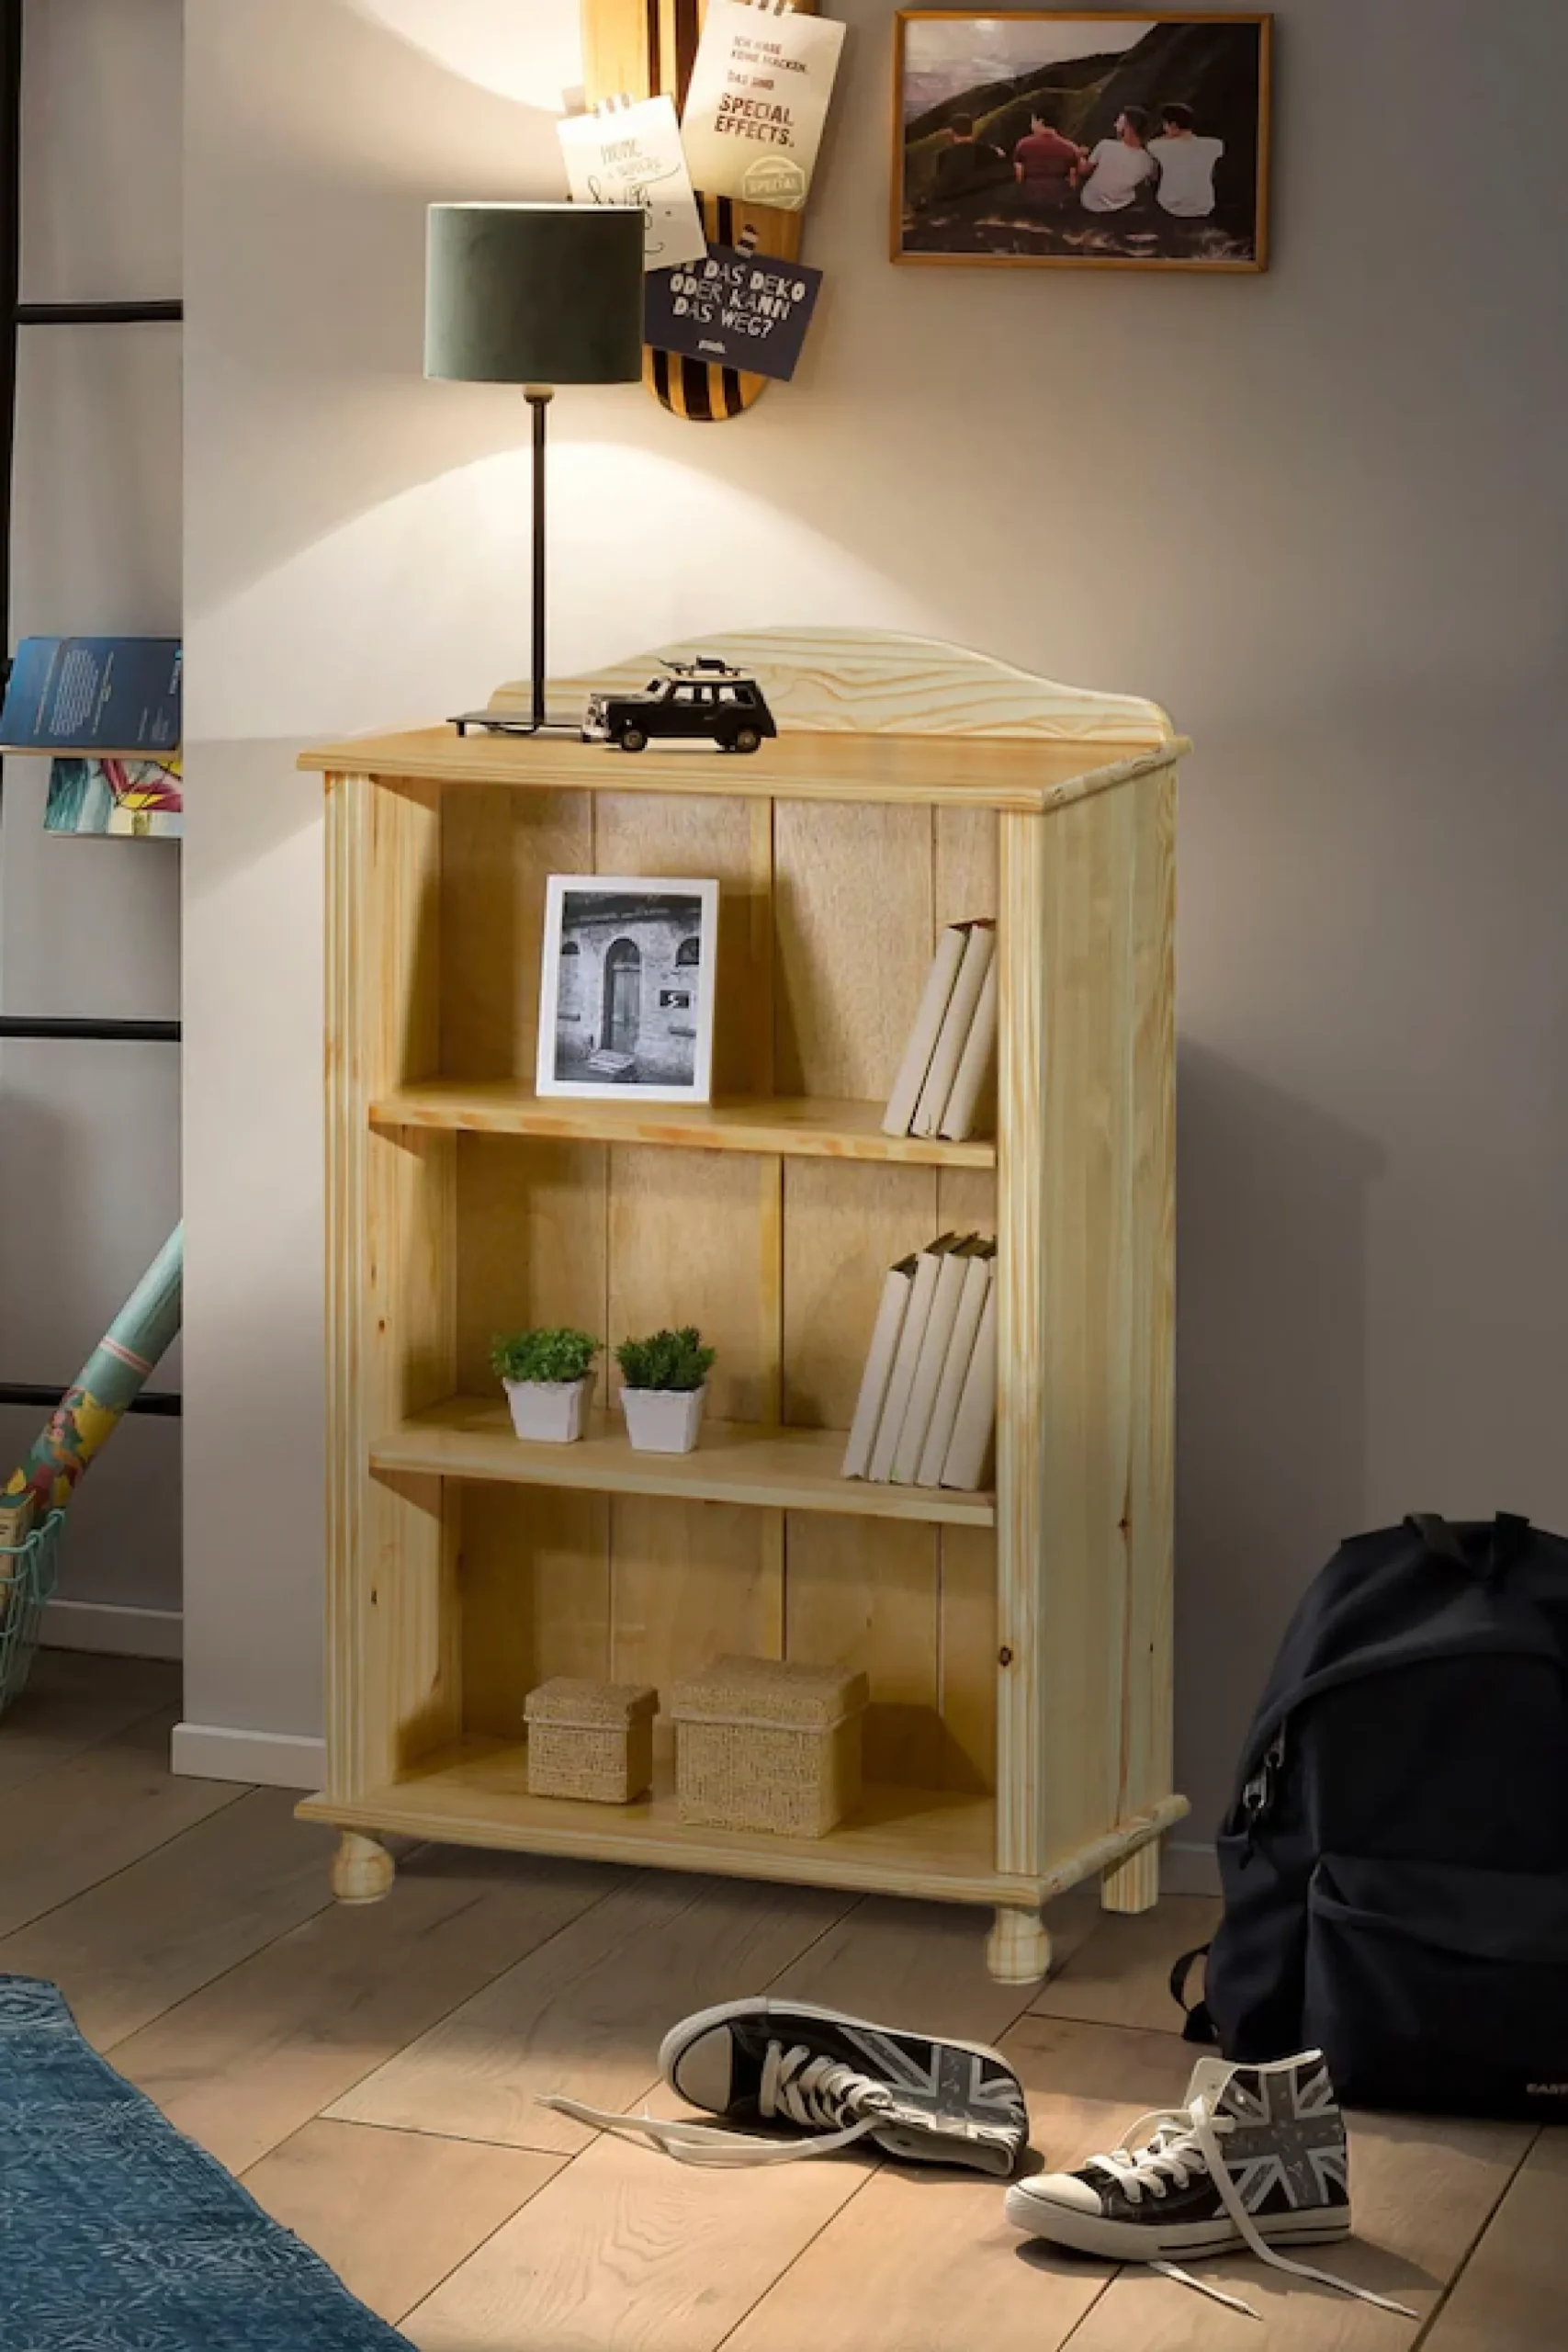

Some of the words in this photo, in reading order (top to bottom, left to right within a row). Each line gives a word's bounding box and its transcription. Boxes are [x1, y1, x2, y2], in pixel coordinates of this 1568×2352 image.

[718, 92, 795, 127] SPECIAL
[714, 115, 795, 148] EFFECTS.
[670, 273, 723, 304] ODER
[728, 288, 792, 320] KANN
[703, 259, 748, 287] DAS
[750, 270, 806, 302] DEKO
[672, 296, 715, 323] DAS
[721, 309, 774, 339] WEG?
